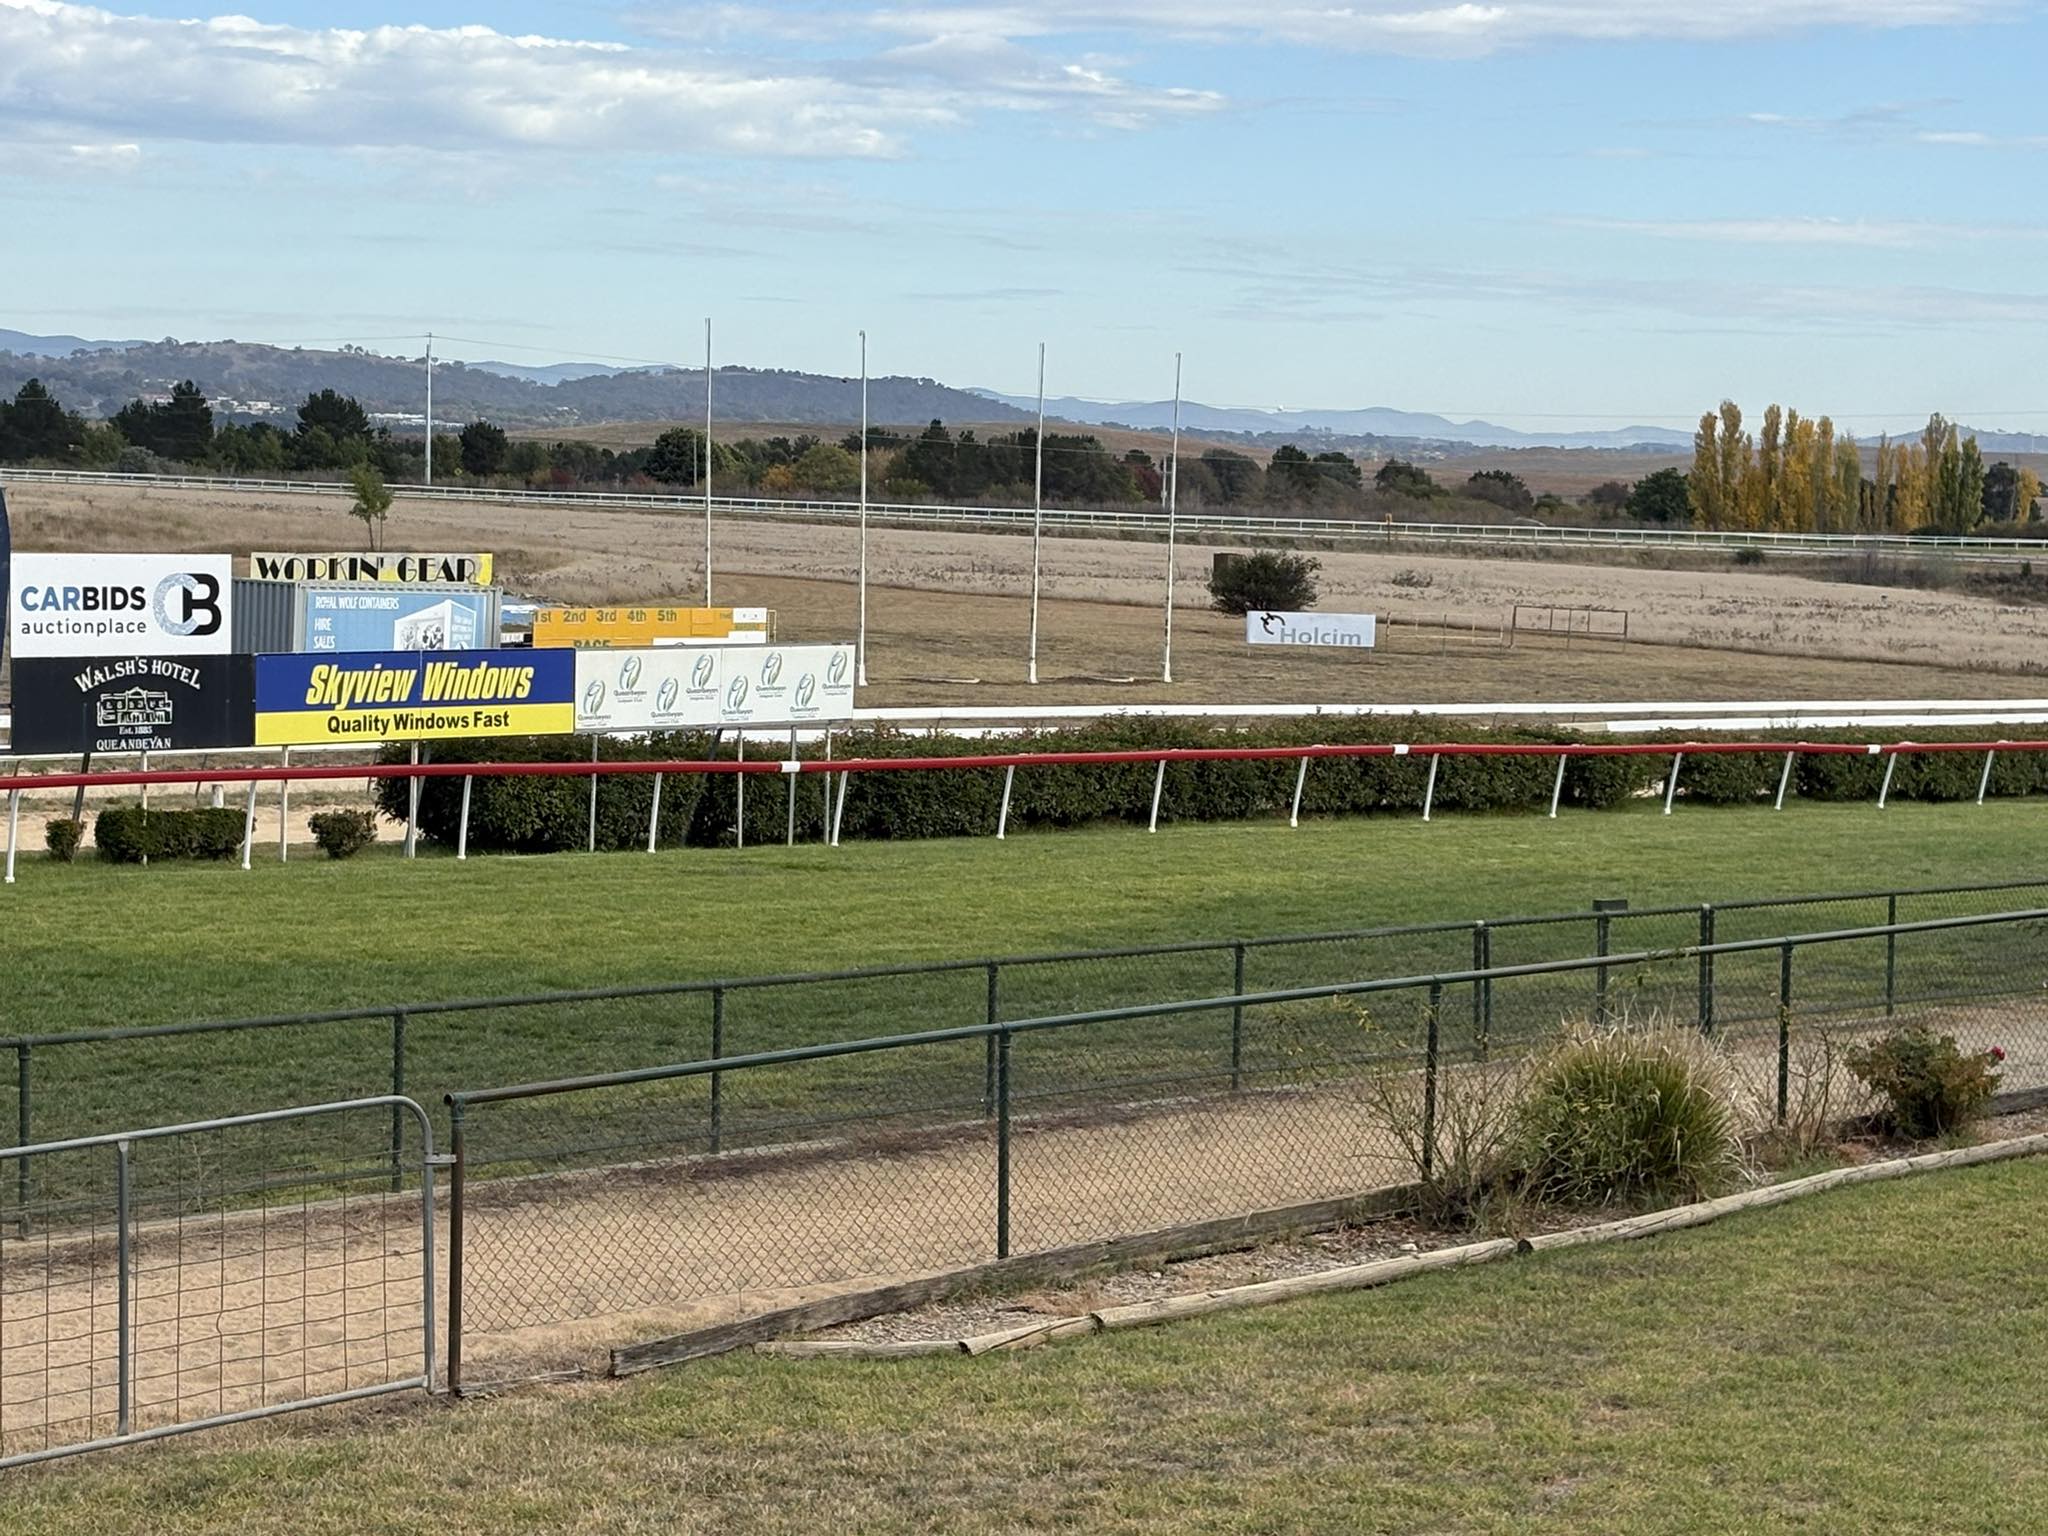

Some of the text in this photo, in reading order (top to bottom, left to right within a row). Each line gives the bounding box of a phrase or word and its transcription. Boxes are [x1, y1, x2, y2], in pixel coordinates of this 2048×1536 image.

[255, 556, 481, 585] WORKIN' GEAR
[20, 586, 147, 612] CARBIDS
[315, 596, 400, 610] ROYAL WOLF CONTAINERS
[314, 617, 332, 631] HIRE
[534, 610, 677, 622] 1st 2nd 3rd 4th 5th
[21, 618, 147, 637] auctionplace
[1280, 627, 1362, 645] Holcim
[313, 635, 336, 649] SALES
[74, 656, 201, 693] WALSH'S HOTEL
[305, 661, 535, 711] Skyview Windows
[327, 710, 510, 736] Quality Windows Fast
